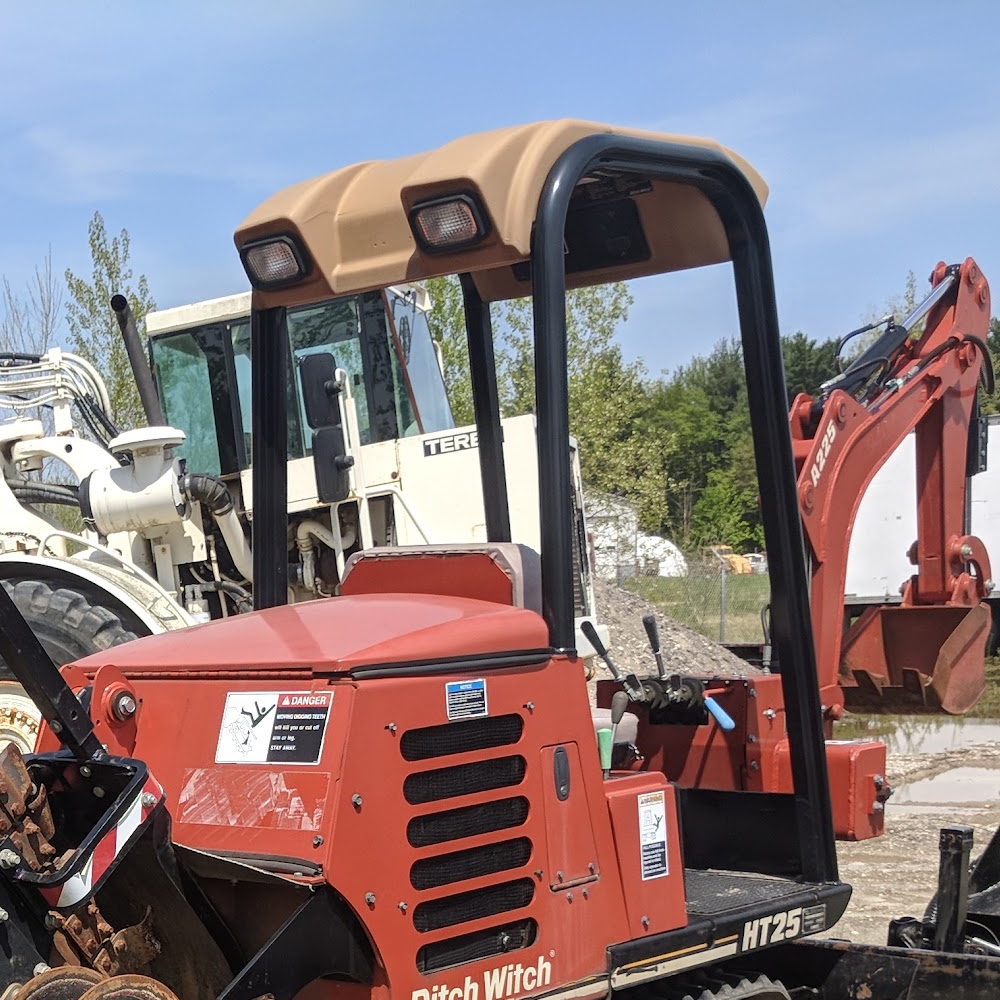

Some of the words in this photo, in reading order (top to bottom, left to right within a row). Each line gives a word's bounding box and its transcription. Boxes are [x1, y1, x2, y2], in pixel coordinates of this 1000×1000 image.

[424, 432, 479, 455] TERE
[810, 418, 837, 488] A225
[291, 696, 326, 705] DANGER
[742, 907, 803, 952] HT25
